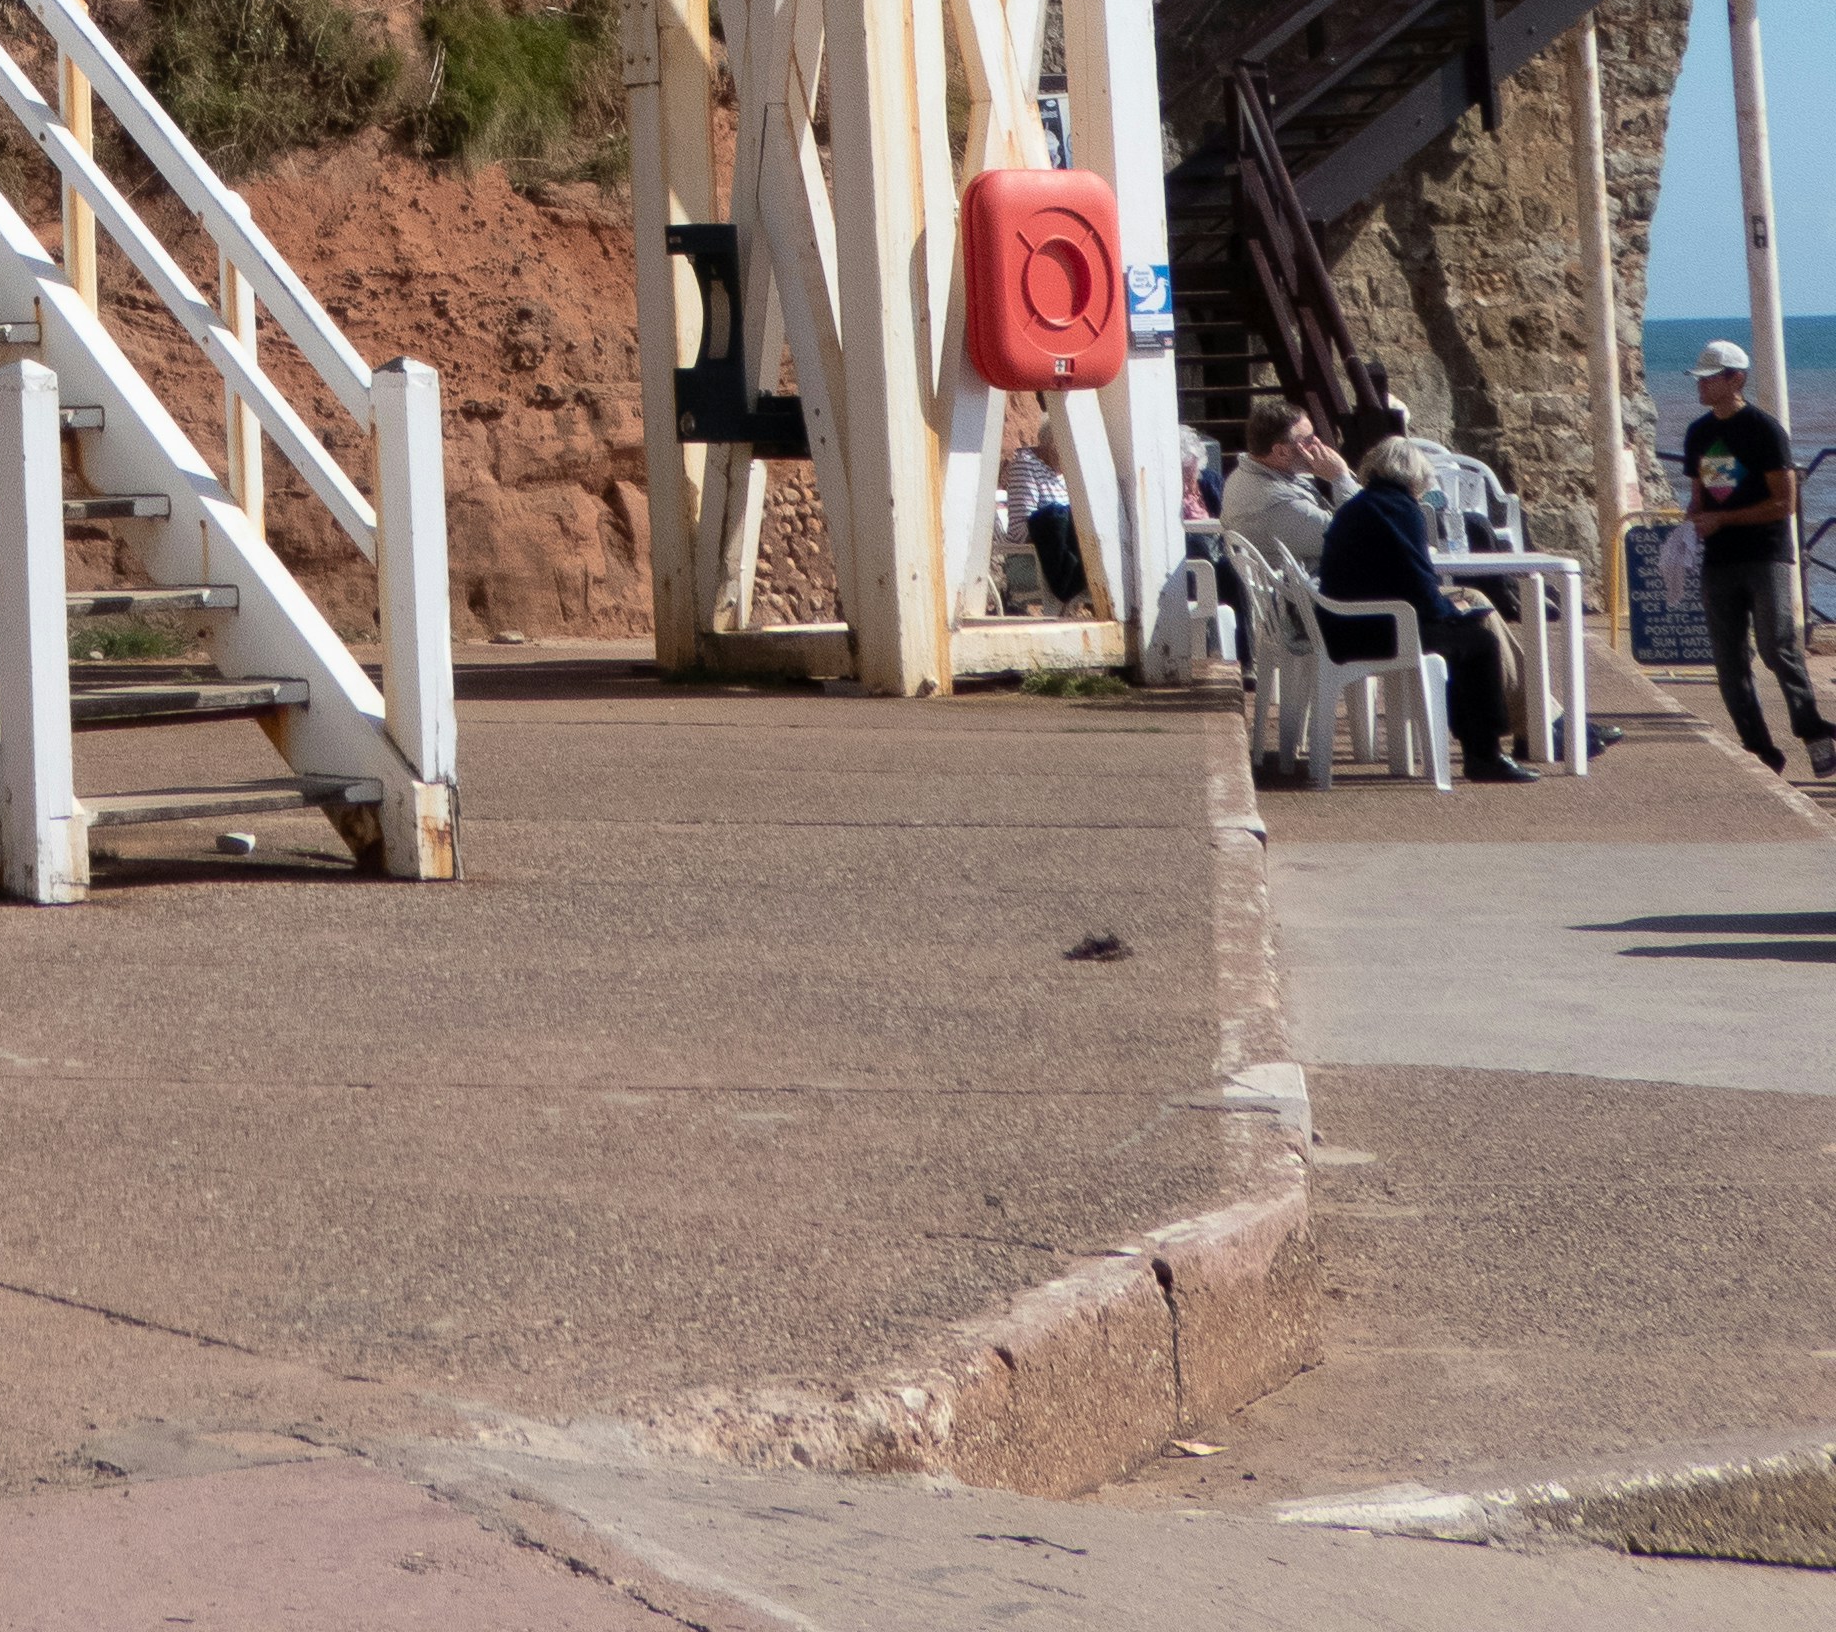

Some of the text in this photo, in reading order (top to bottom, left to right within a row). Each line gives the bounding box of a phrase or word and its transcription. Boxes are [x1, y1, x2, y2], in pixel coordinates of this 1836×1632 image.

[1635, 544, 1660, 556] COL
[1652, 636, 1713, 649] SUN HATS
[1638, 648, 1679, 660] BEACH
